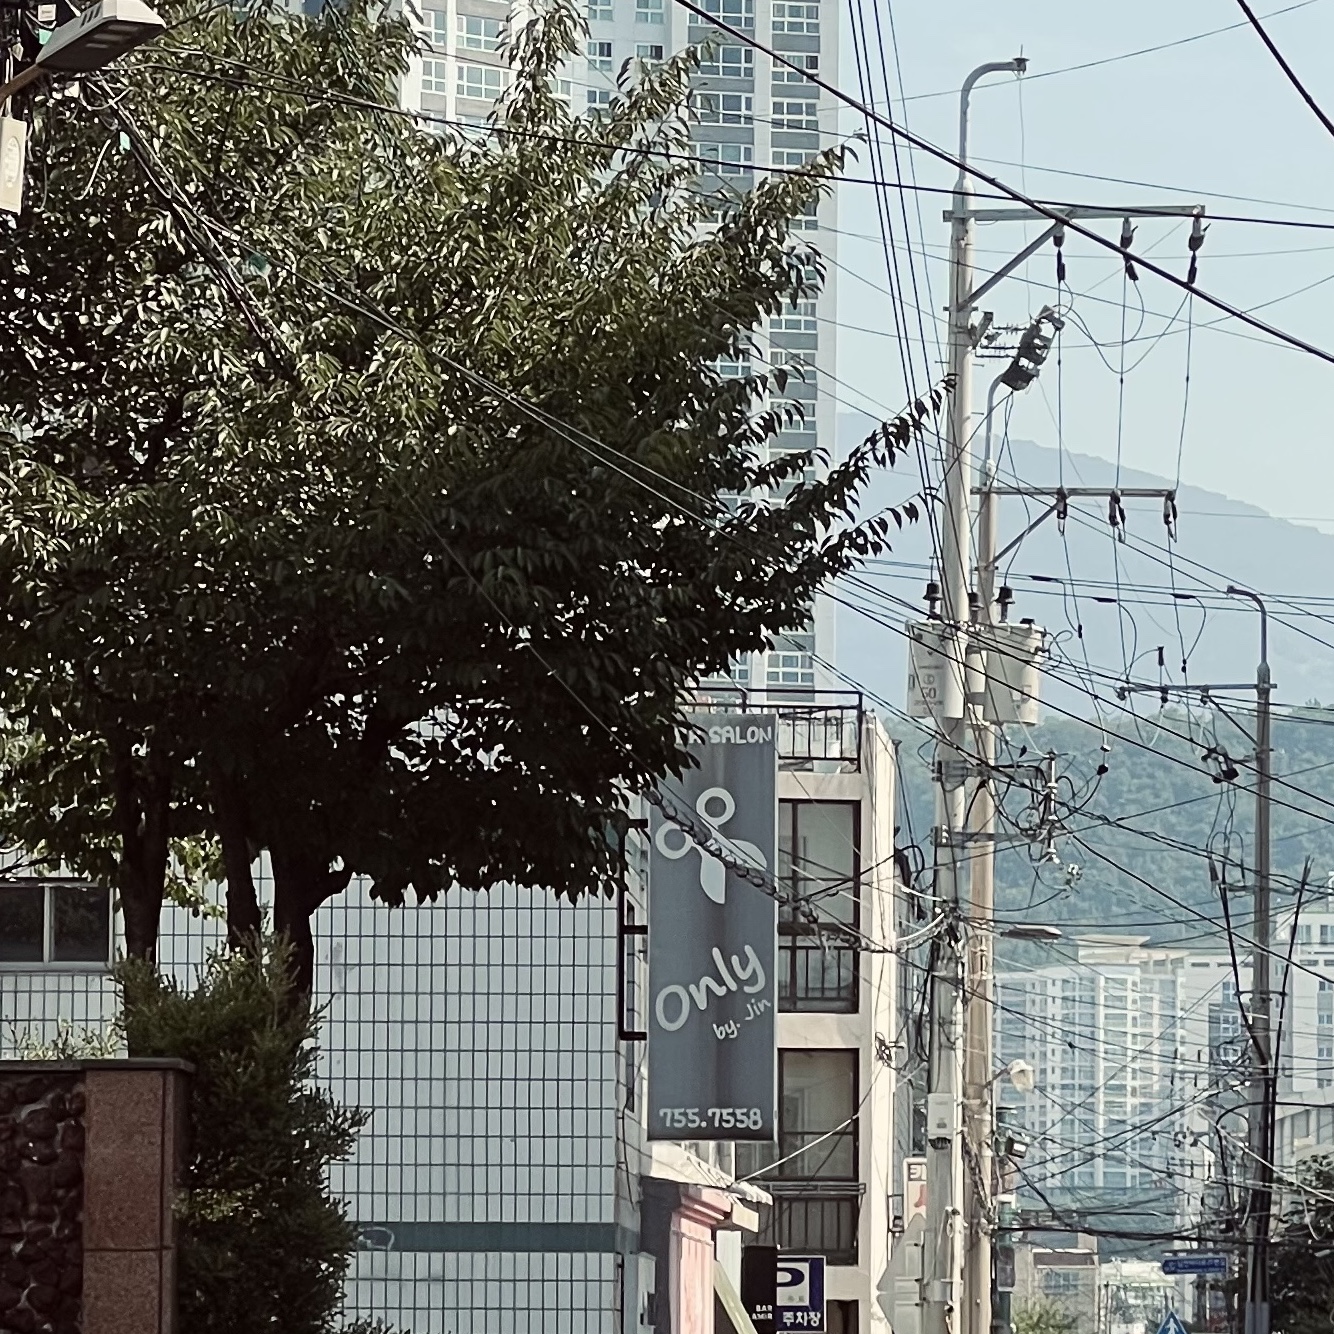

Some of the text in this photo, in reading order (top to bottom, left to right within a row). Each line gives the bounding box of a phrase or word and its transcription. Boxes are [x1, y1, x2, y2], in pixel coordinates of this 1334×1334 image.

[708, 725, 772, 744] SALON
[655, 944, 766, 1032] Only
[659, 1108, 763, 1131] 755.7558
[783, 1311, 821, 1327] 주차장
